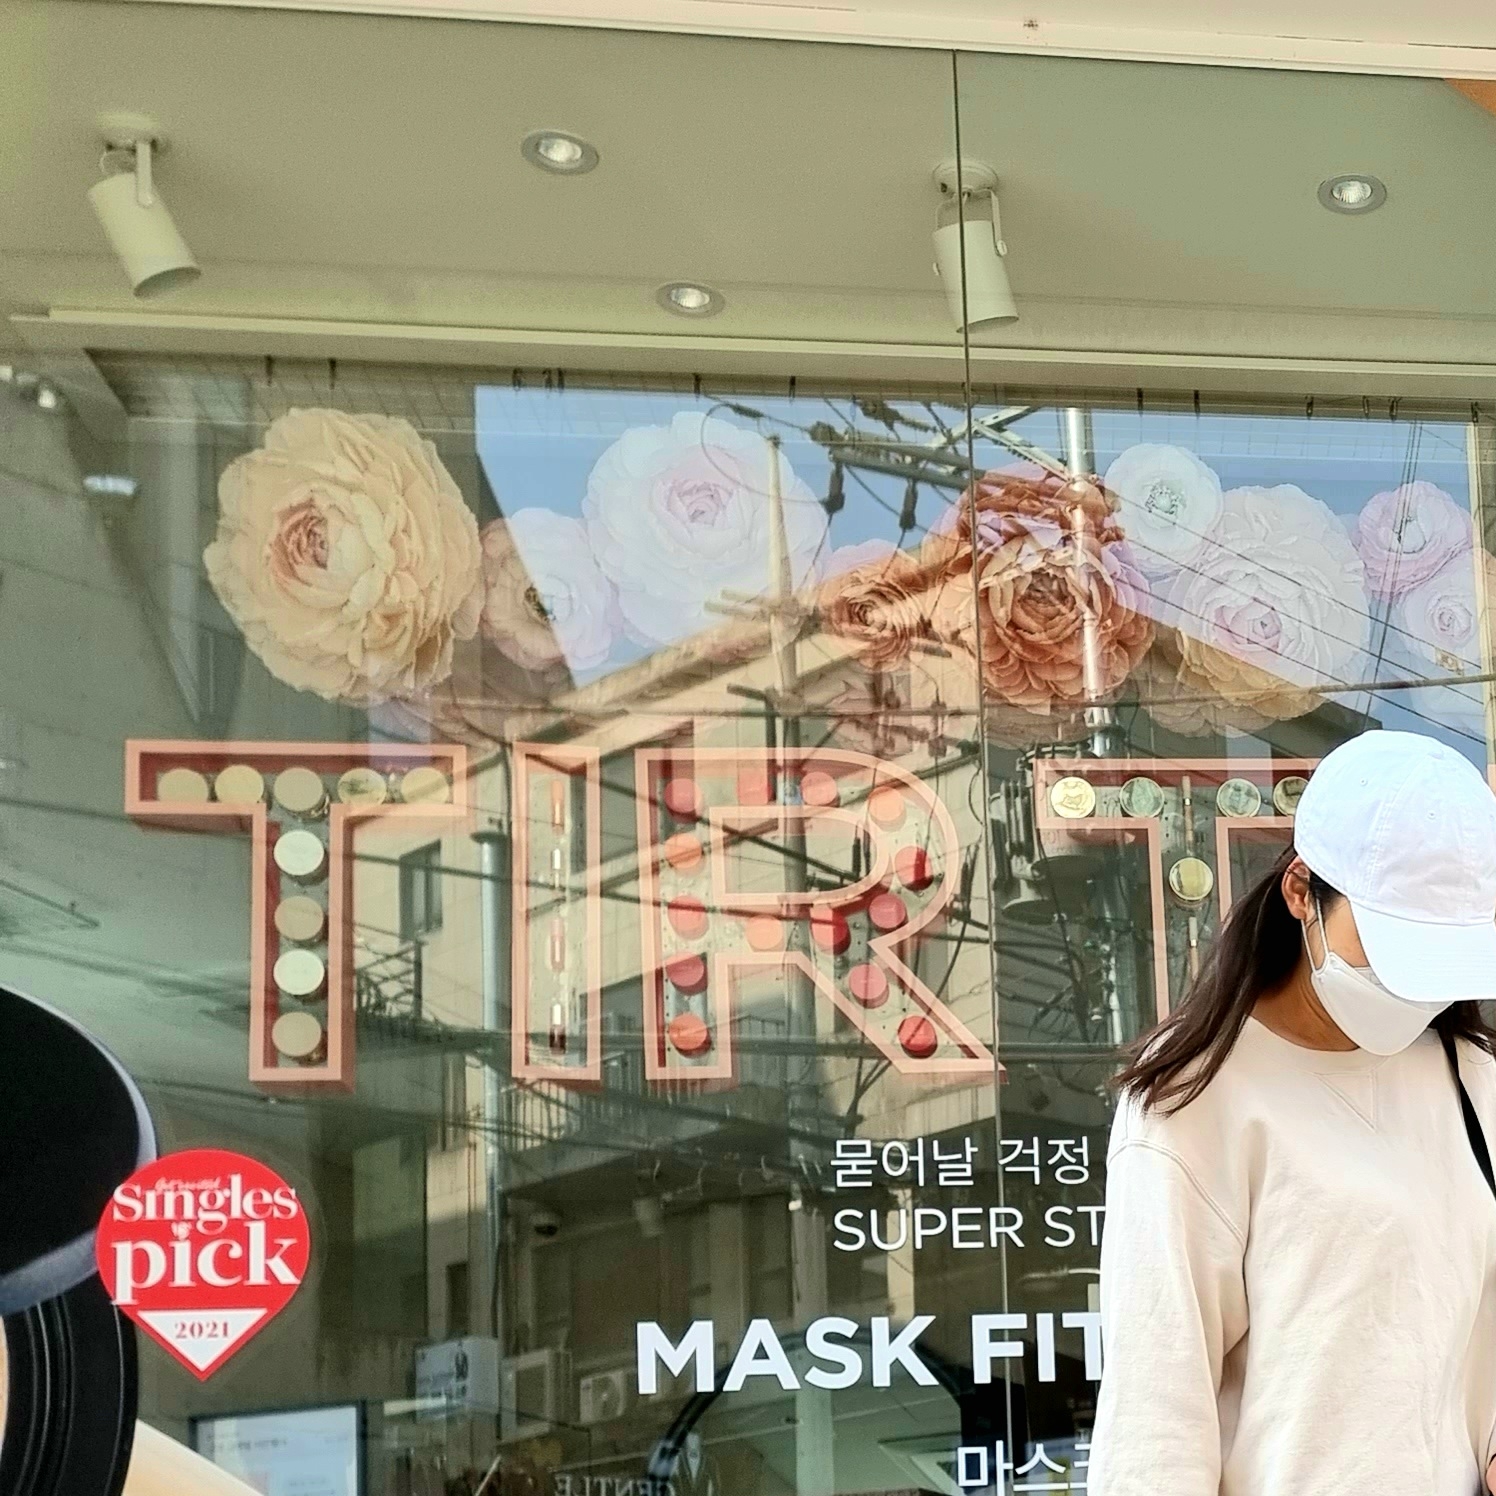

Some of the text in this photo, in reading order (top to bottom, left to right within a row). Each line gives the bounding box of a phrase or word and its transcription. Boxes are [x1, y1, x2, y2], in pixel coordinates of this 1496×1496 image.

[830, 1135, 1090, 1188] 묻어날 걱정
[112, 1173, 299, 1236] Singles
[833, 1206, 1025, 1252] SUPER
[111, 1220, 301, 1306] pick
[174, 1319, 231, 1339] 2021
[636, 1314, 940, 1395] MASK
